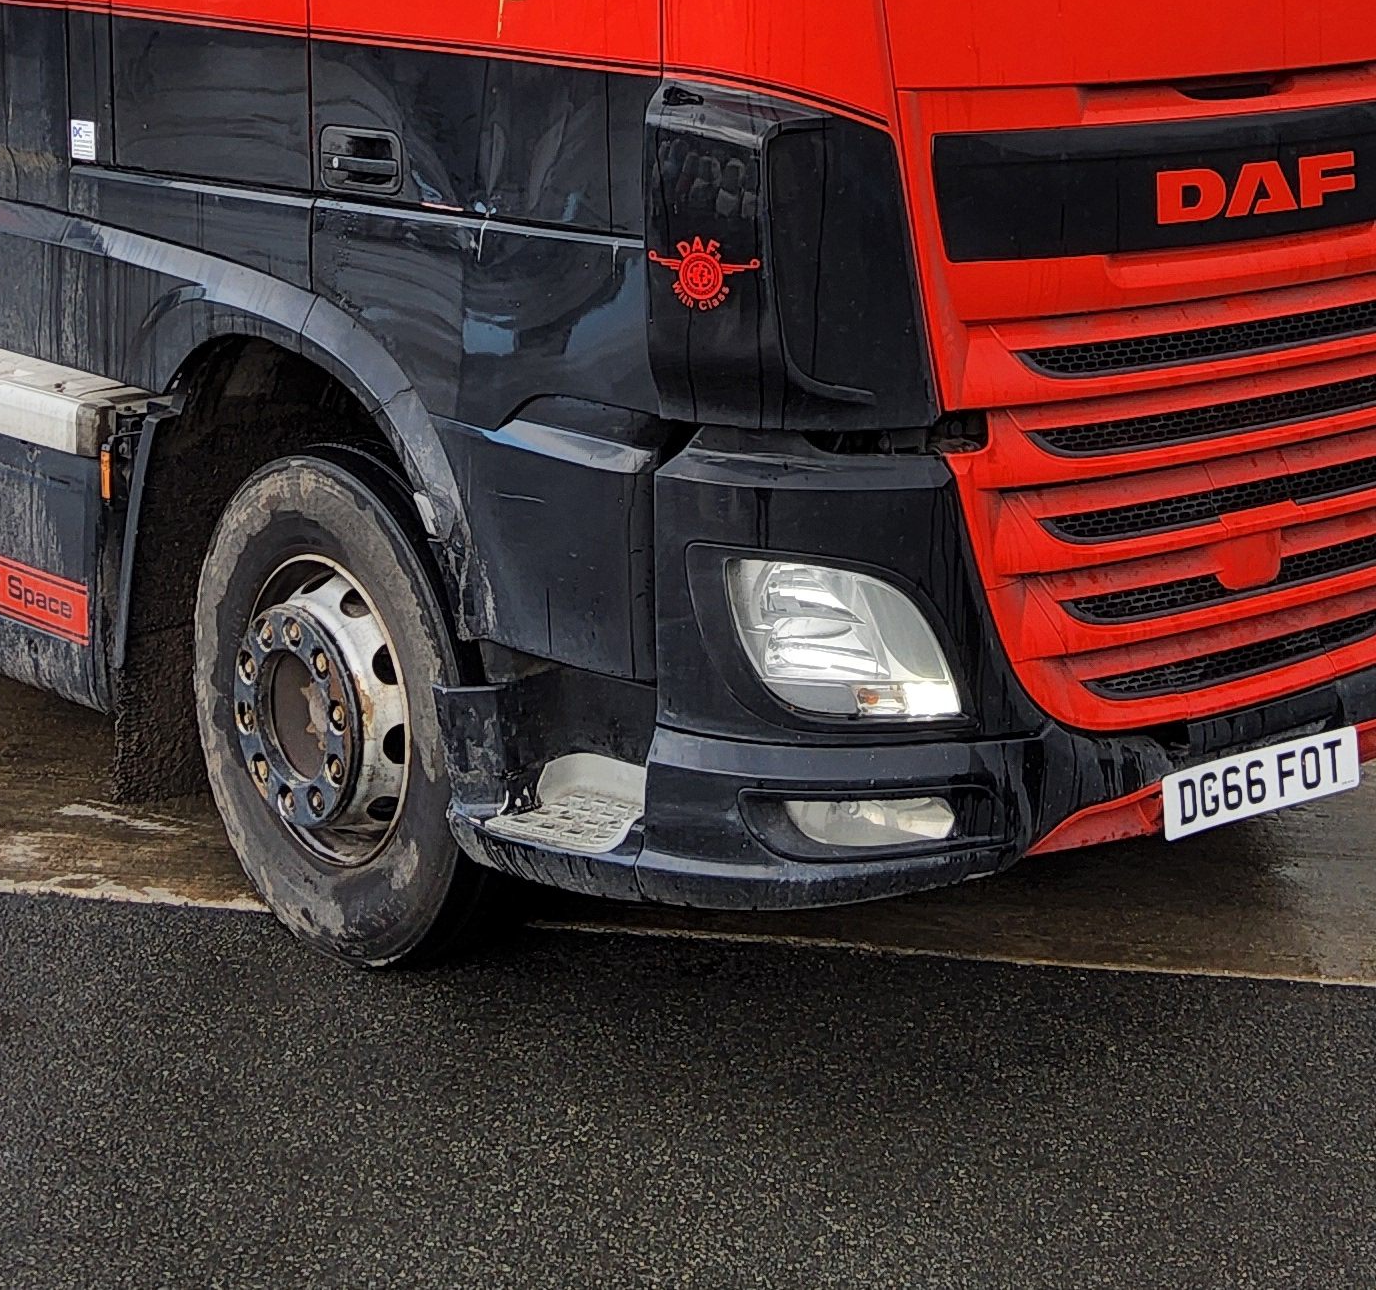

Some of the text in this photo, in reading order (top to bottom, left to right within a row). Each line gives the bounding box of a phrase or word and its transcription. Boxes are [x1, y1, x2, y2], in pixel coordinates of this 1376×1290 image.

[1156, 150, 1356, 225] DAF
[672, 281, 729, 310] With Class
[7, 573, 73, 620] Space
[1177, 738, 1342, 826] DG66 FOT
